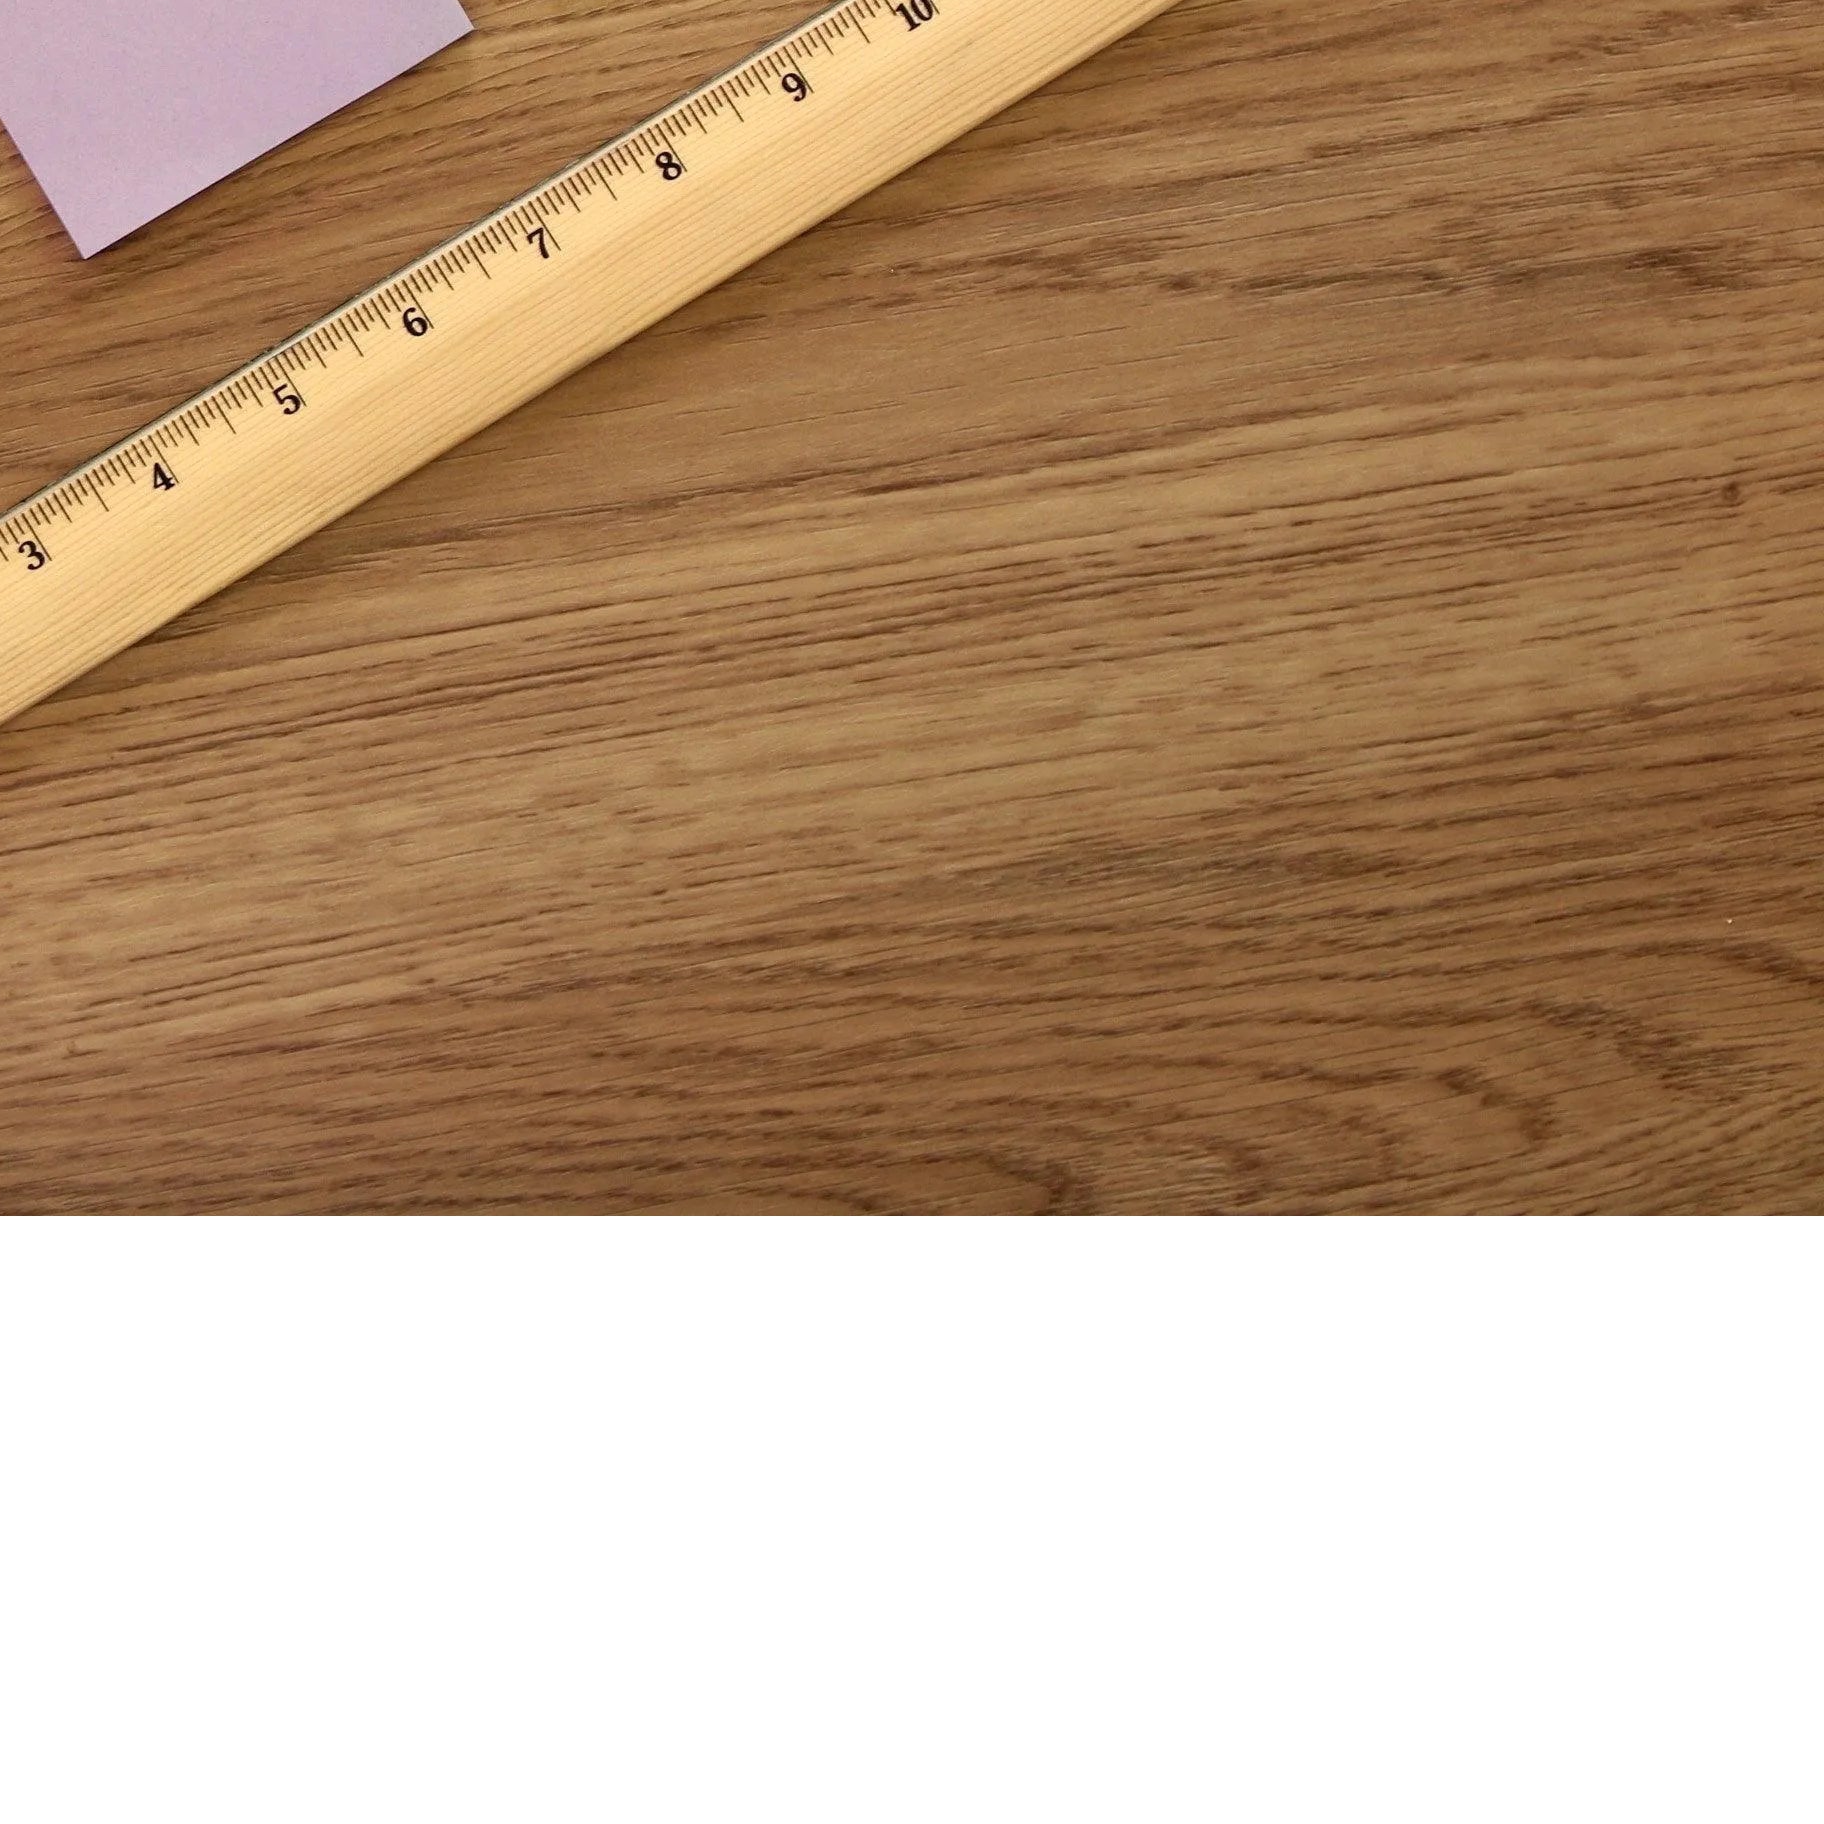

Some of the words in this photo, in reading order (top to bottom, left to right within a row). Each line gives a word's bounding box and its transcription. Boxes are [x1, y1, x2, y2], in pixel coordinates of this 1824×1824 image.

[781, 72, 808, 103] 9
[655, 151, 684, 182] 8
[527, 227, 554, 260] 7
[402, 306, 430, 337] 6
[272, 384, 301, 416] 5
[152, 461, 176, 492] 4
[18, 540, 46, 572] 3
